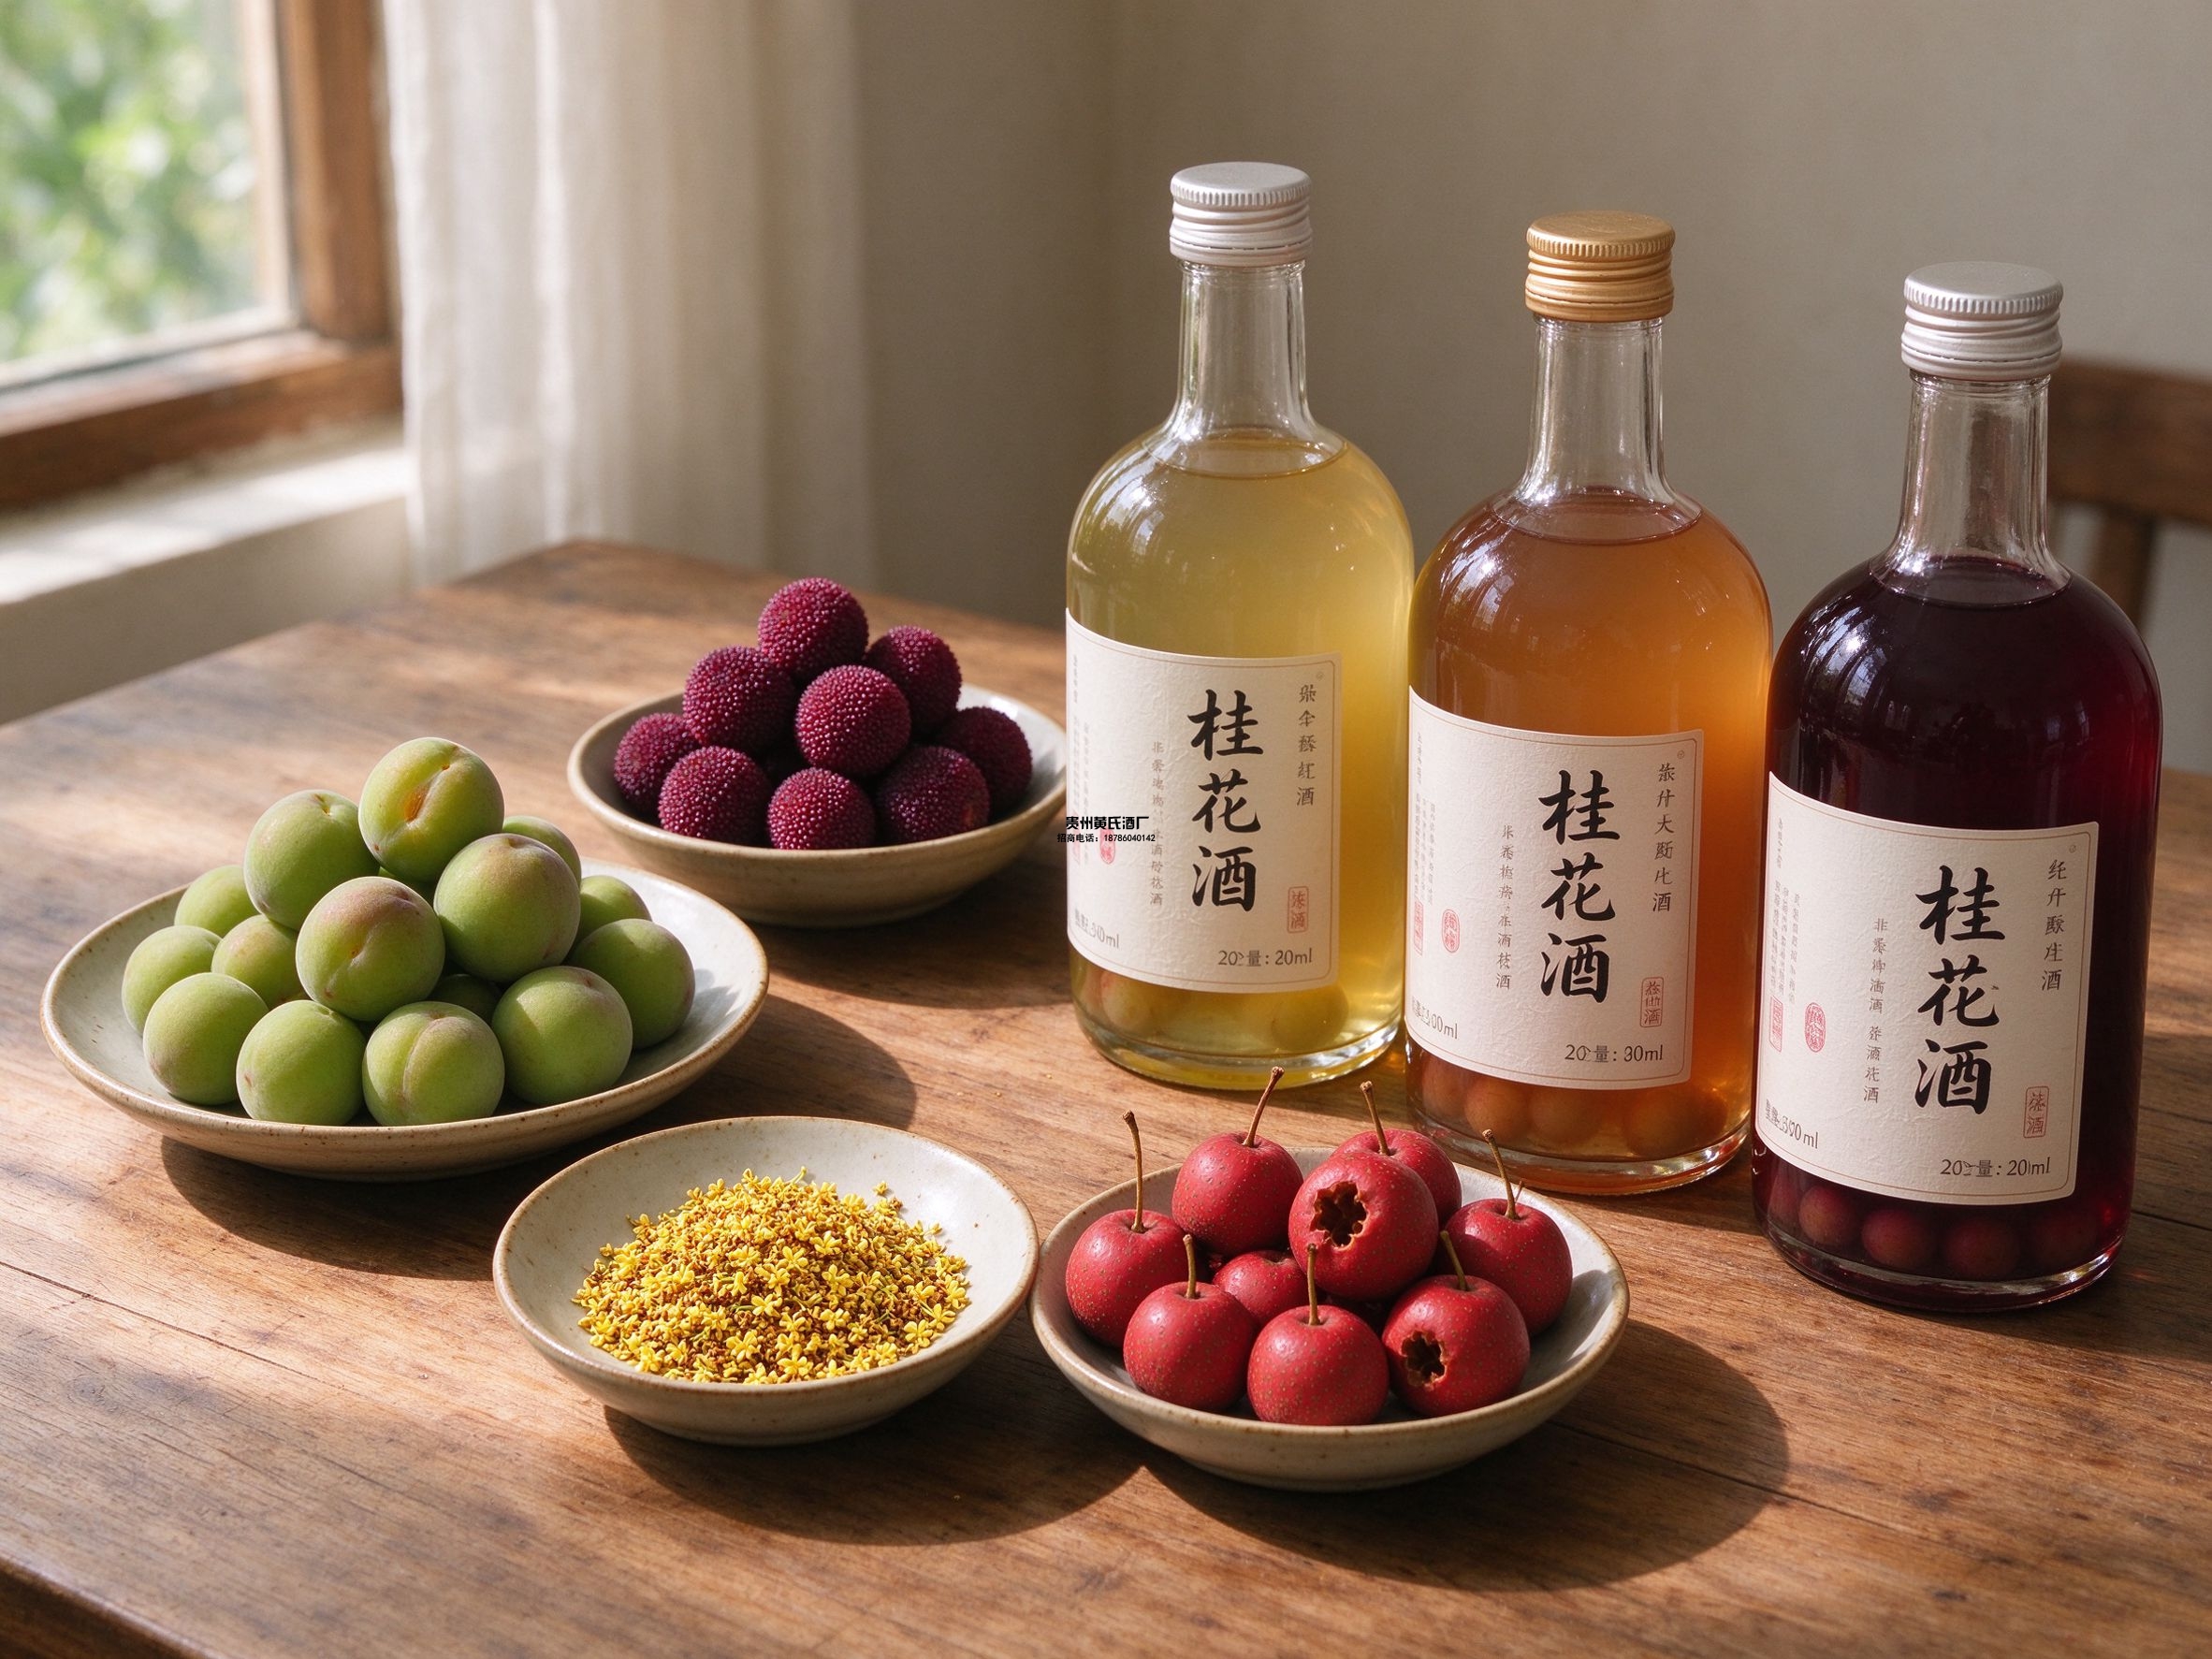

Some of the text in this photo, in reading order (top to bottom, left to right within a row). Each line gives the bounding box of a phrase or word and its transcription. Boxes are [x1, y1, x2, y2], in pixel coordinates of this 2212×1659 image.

[1186, 689, 1264, 911] 桂花酒
[1537, 769, 1621, 1003] 桂花酒
[1914, 865, 2006, 1115] 桂花酒
